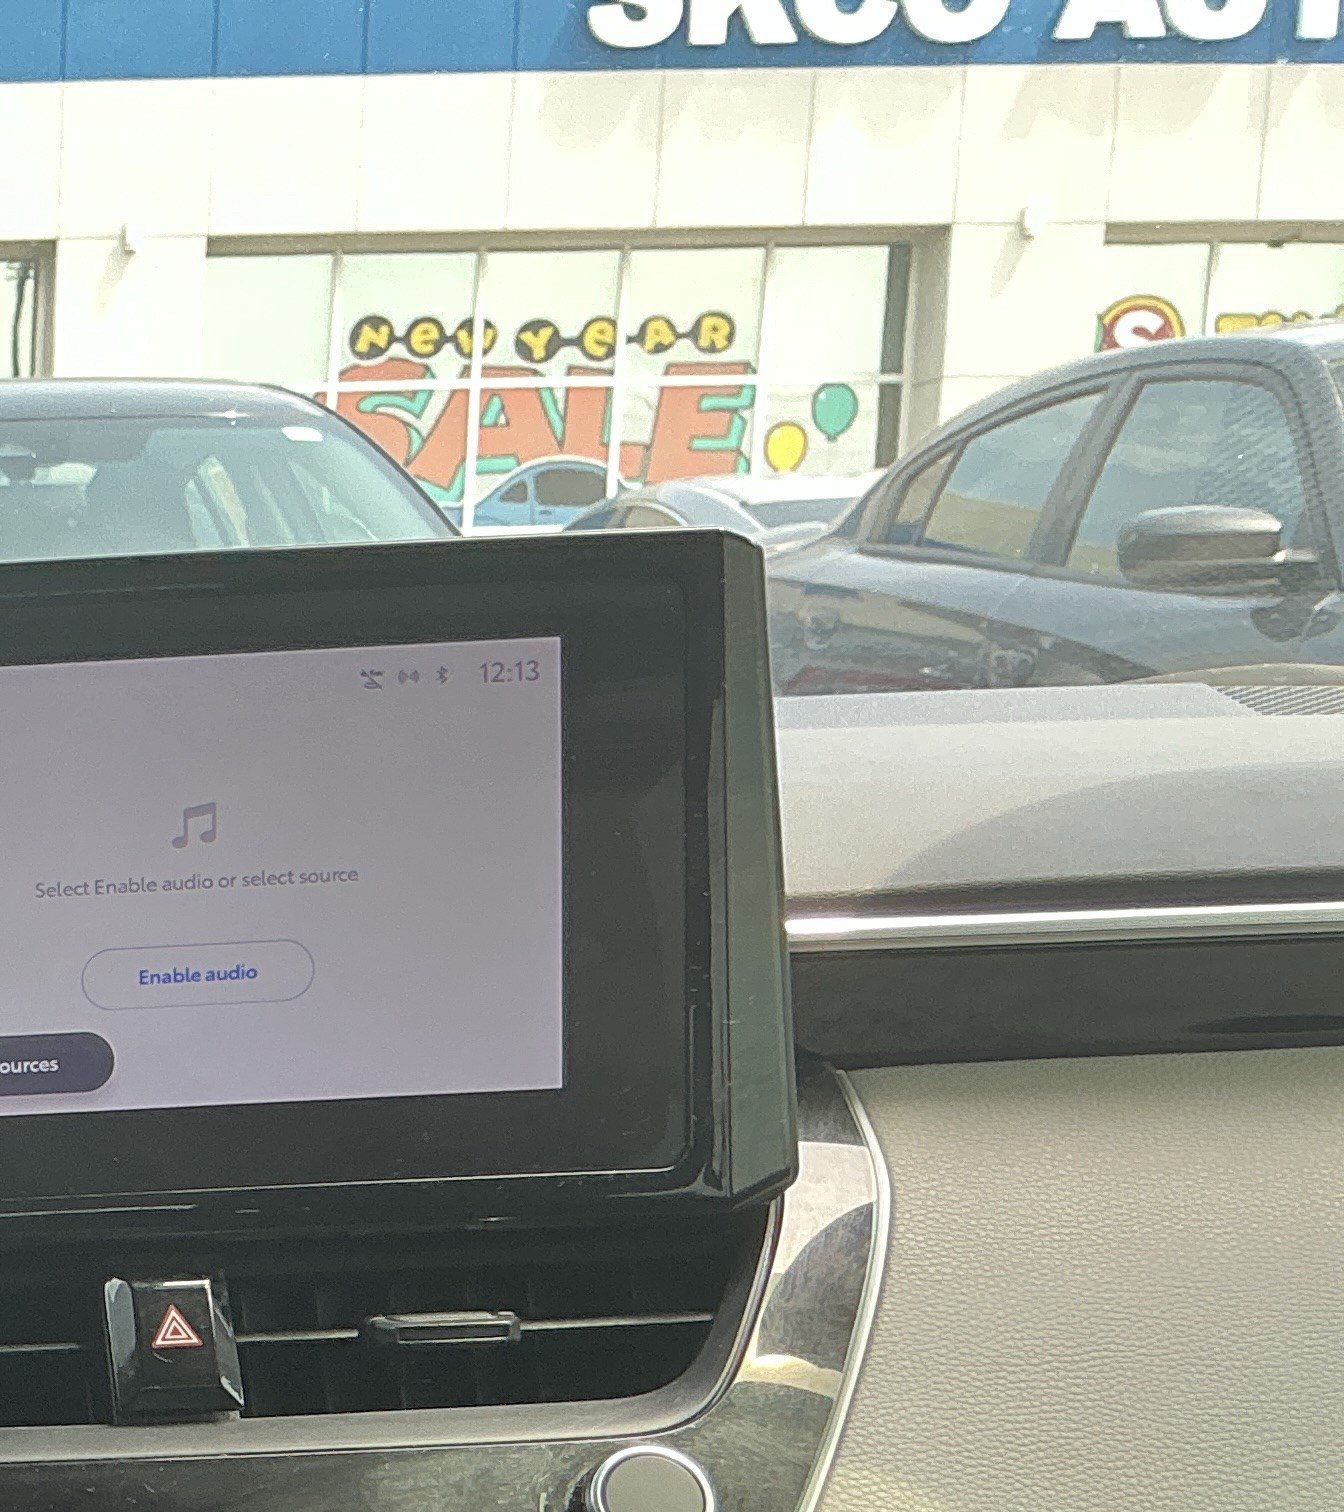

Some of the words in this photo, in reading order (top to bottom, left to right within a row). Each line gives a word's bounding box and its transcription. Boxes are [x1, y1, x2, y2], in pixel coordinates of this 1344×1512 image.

[333, 357, 755, 490] SALE
[479, 660, 541, 683] 12:13
[34, 880, 91, 899] Select
[94, 875, 158, 896] Enable
[161, 873, 214, 892] audio
[217, 872, 238, 889] or
[241, 867, 296, 888] select
[298, 866, 360, 885] source
[138, 967, 202, 986] Enable
[205, 963, 259, 983] audio
